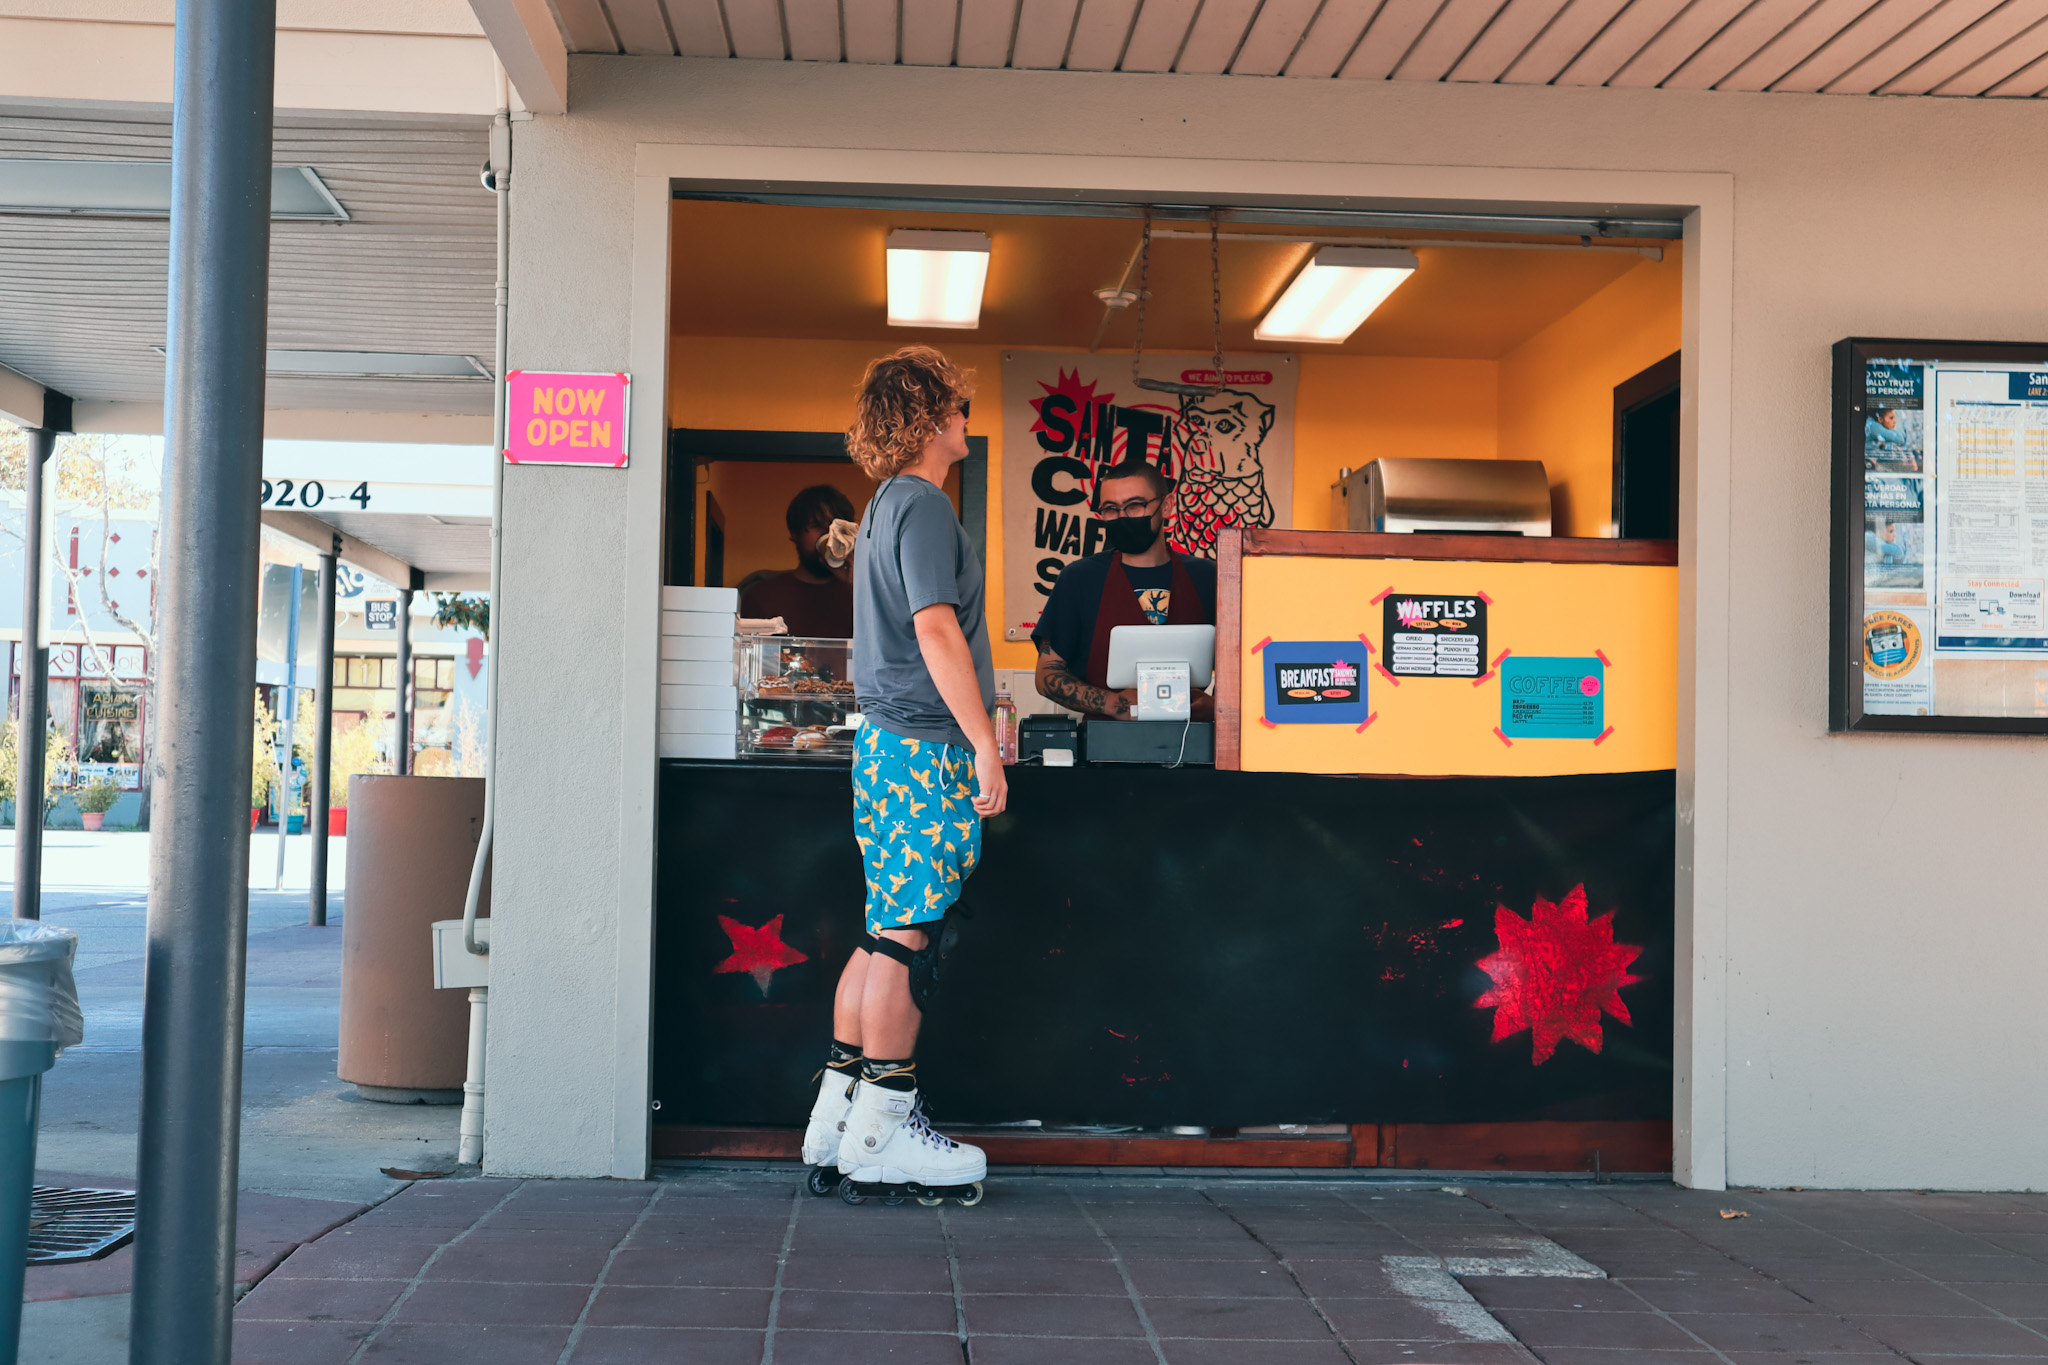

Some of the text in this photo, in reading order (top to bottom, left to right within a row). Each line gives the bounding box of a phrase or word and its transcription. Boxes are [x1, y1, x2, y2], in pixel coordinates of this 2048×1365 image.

[1188, 373, 1201, 382] WE
[1234, 374, 1266, 383] PLEASE
[1872, 371, 1890, 379] YOU
[2029, 372, 2048, 385] San
[1866, 379, 1914, 387] ALLY TRUST
[1866, 387, 1914, 396] HIS PERSON?
[533, 387, 606, 416] NOW
[526, 418, 611, 448] OPEN
[1036, 394, 1172, 476] SANTA
[1895, 492, 1907, 500] EN
[1879, 501, 1921, 509] PERSONA?
[1968, 580, 2020, 588] Stay Connected
[1945, 590, 2041, 599] Subscribe Download
[371, 602, 390, 612] BUS
[1396, 600, 1477, 619] WAFFLES
[368, 612, 393, 622] STOP
[1864, 615, 1913, 629] FREE FARES
[49, 649, 75, 673] TO
[1280, 668, 1335, 688] BREAKFAST
[92, 693, 132, 704] ASIAN
[86, 707, 136, 718] CUISINE
